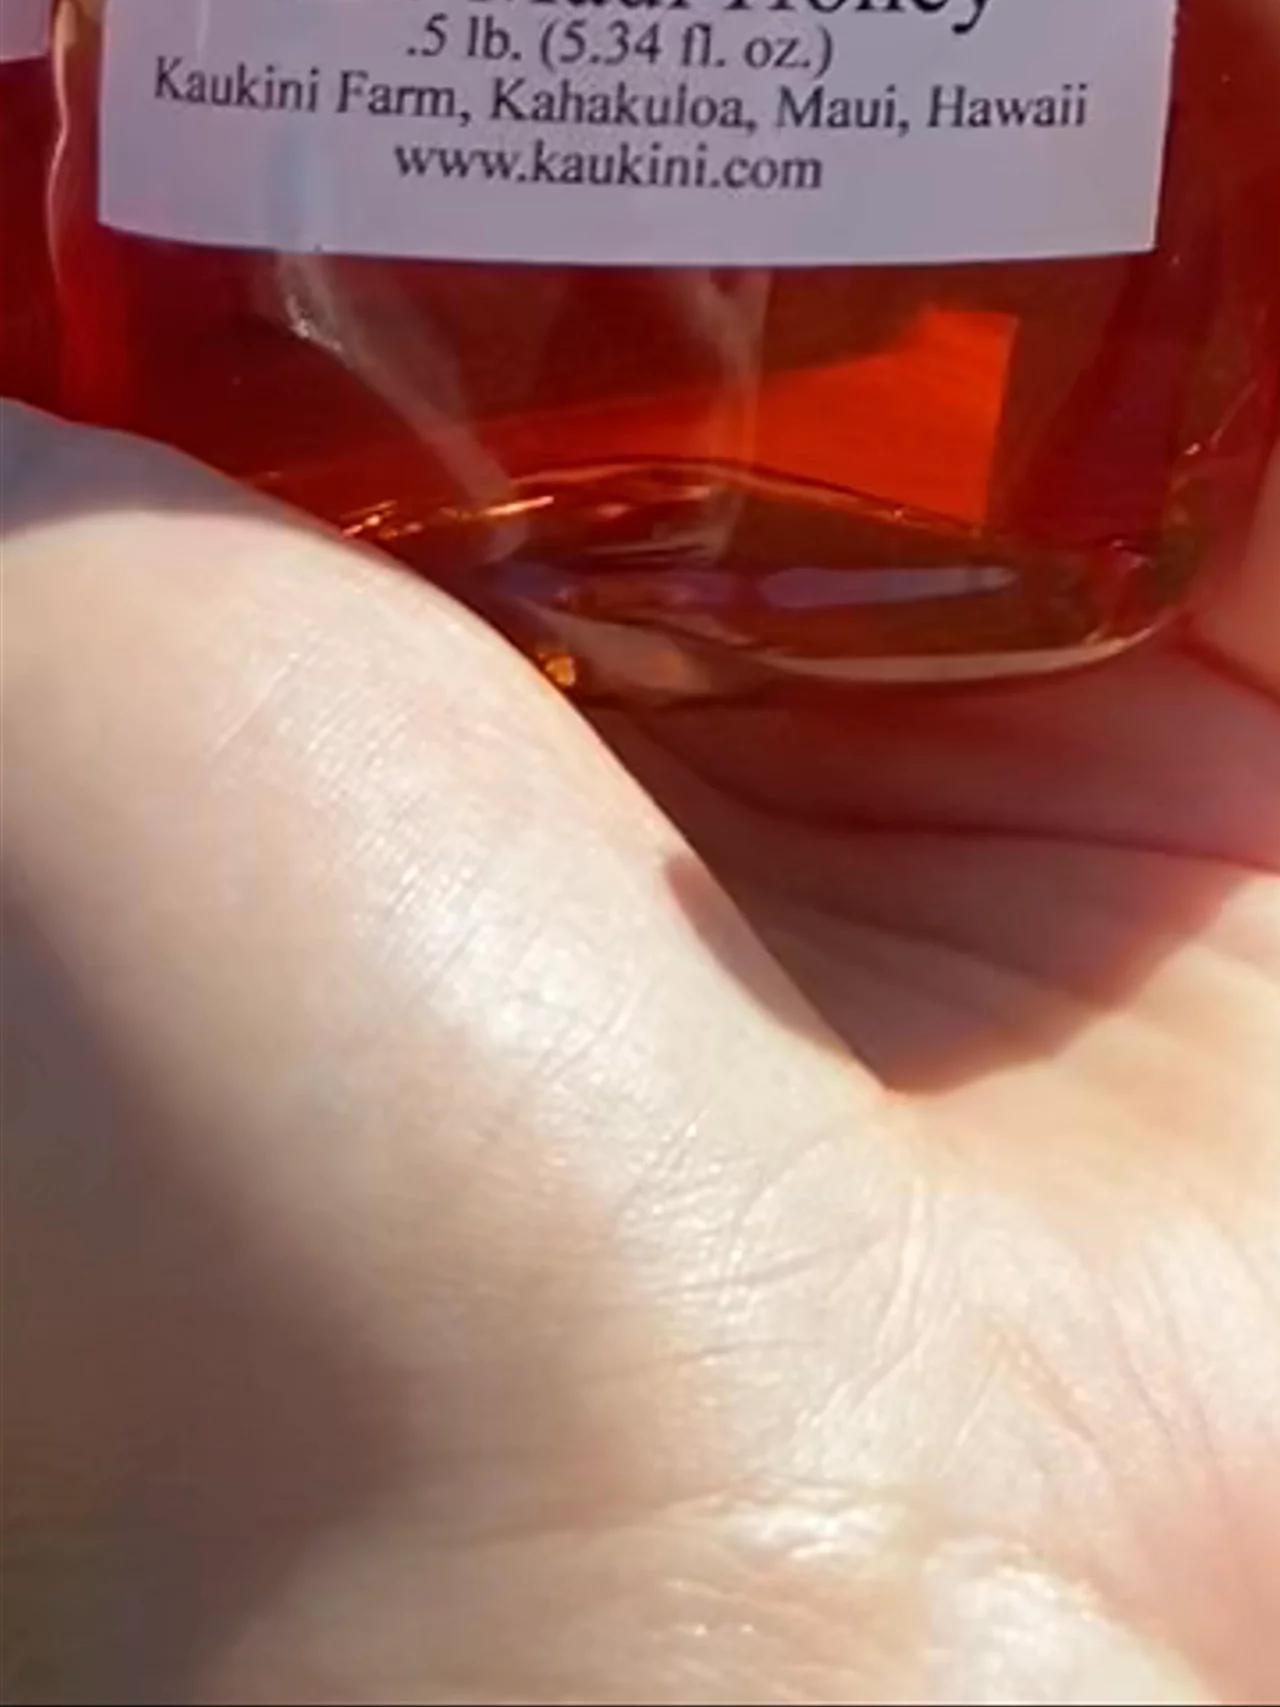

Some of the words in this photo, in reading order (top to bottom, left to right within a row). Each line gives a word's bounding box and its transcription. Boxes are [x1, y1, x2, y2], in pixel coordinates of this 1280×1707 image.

[406, 12, 448, 59] .5
[466, 15, 522, 62] lb.
[540, 19, 662, 72] (5.34
[678, 21, 727, 69] fl.
[744, 26, 834, 79] oz.)
[153, 56, 320, 114] Kaukini
[336, 68, 472, 128] Farm,
[489, 77, 758, 134] Kahakuloa,
[775, 84, 910, 138] Maui,
[926, 83, 1088, 129] Hawaii
[394, 139, 824, 190] www.kaukini.com
